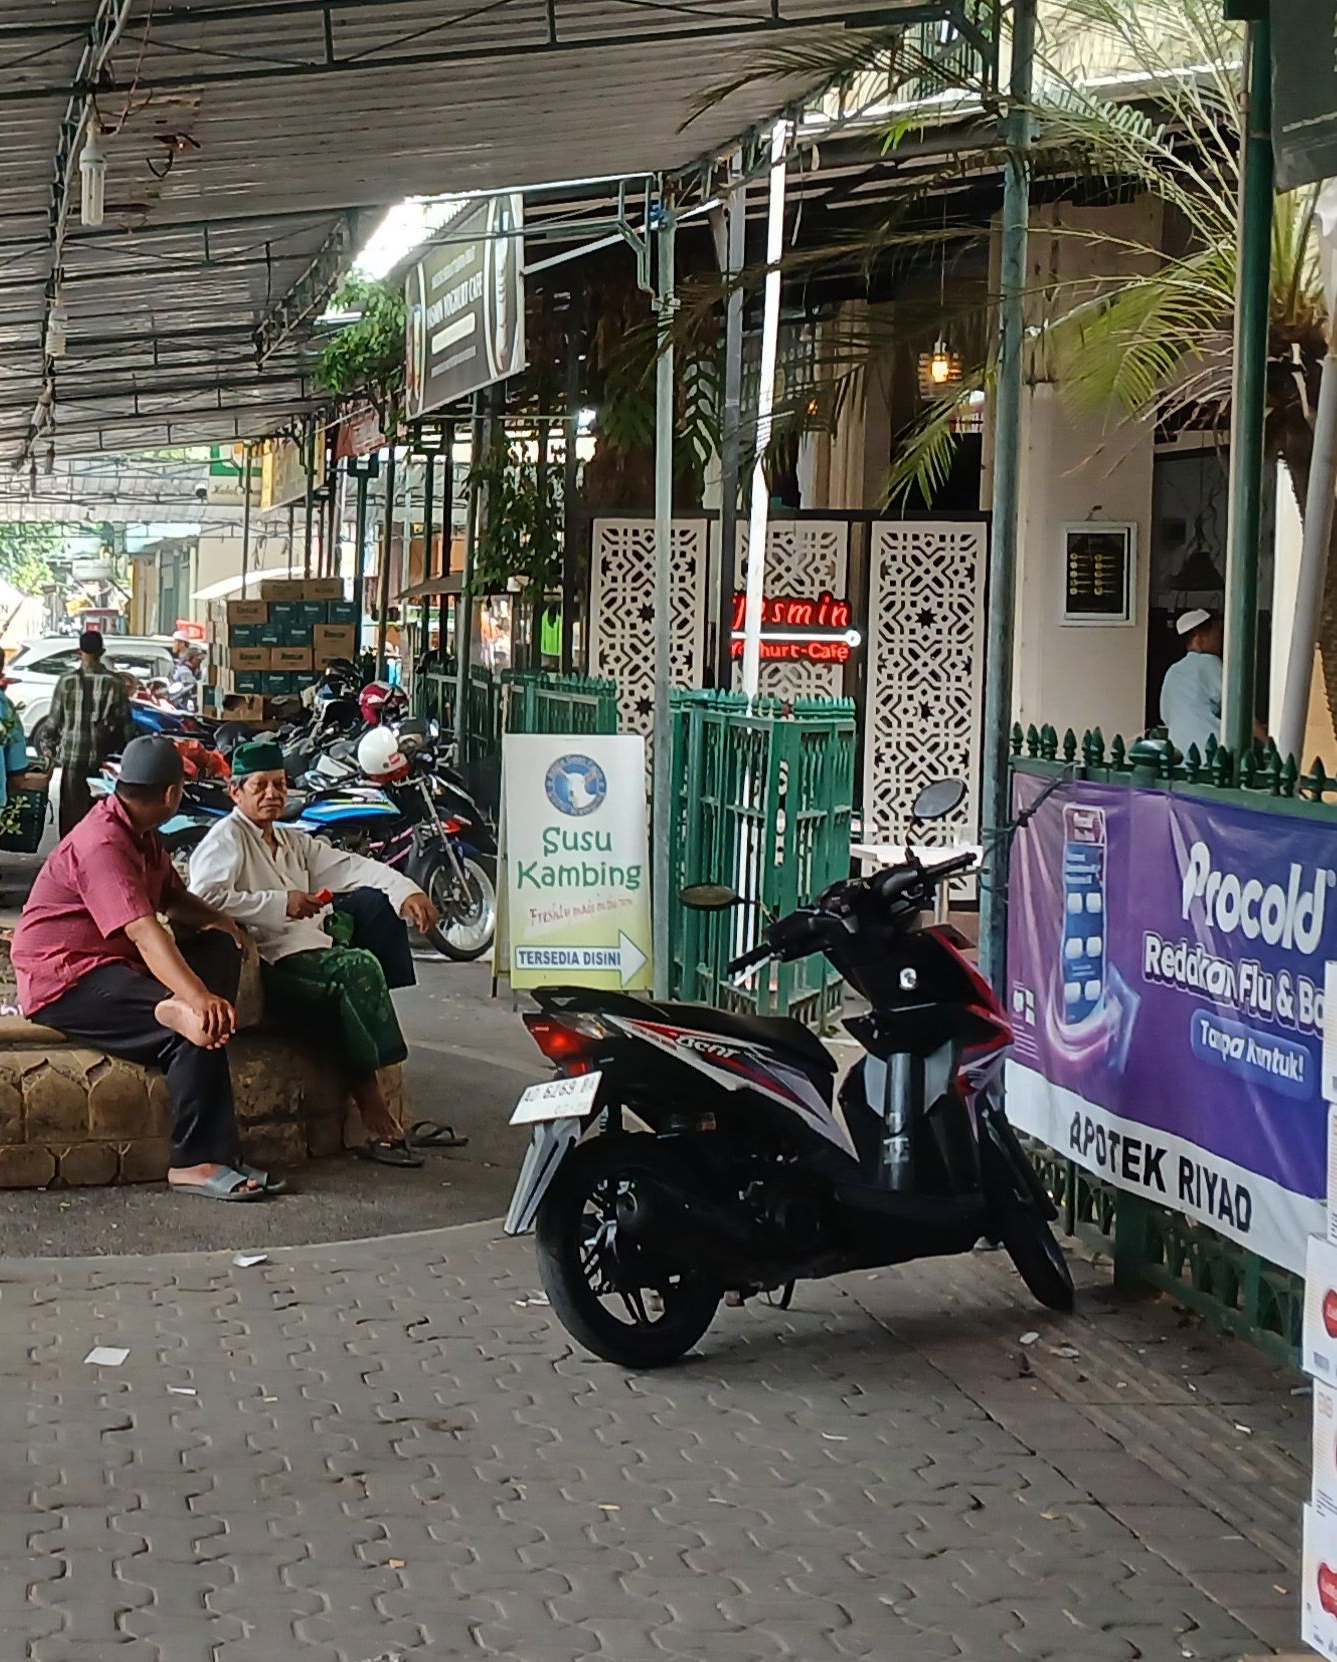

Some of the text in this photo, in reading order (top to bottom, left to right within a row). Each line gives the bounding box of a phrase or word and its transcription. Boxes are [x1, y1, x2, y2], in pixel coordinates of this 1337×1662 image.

[542, 827, 613, 857] Susu
[517, 860, 642, 890] Kambing
[1183, 841, 1327, 954] Procold
[519, 951, 621, 966] TERSEDIA DISINI
[1145, 936, 1239, 999] Redakan
[1239, 963, 1273, 1011] Flu
[1277, 973, 1295, 1018] &
[1070, 1111, 1252, 1233] APOTEK RIYAD
